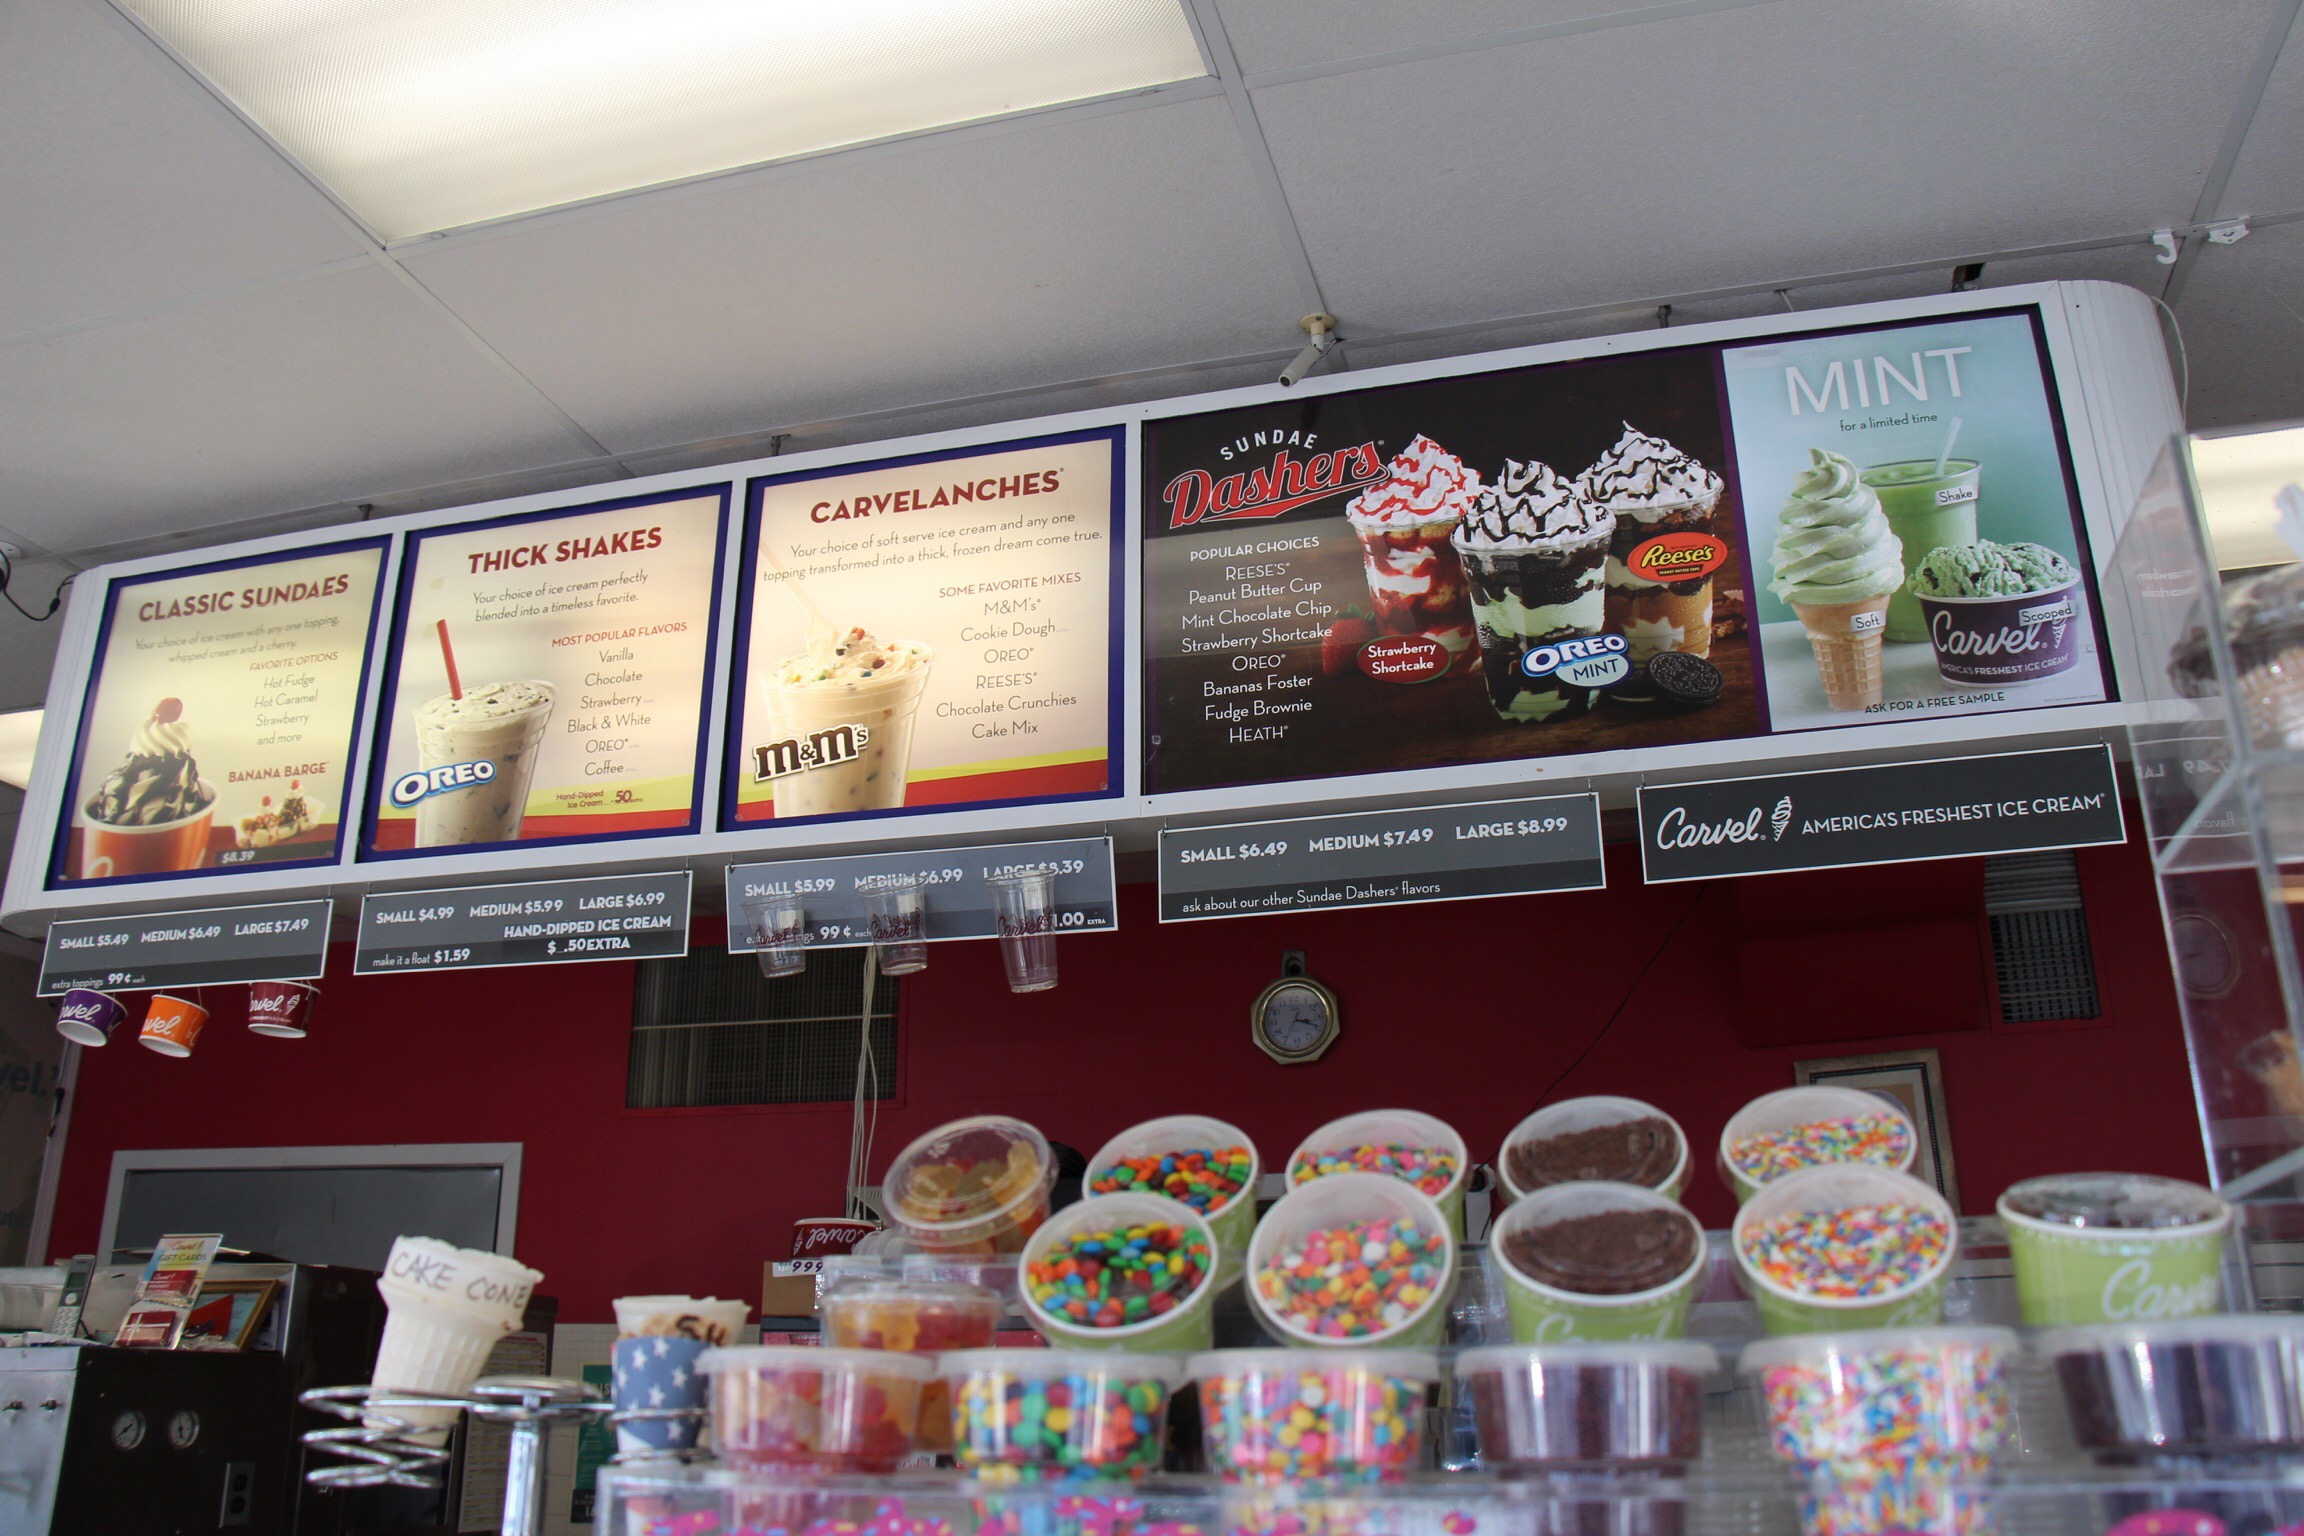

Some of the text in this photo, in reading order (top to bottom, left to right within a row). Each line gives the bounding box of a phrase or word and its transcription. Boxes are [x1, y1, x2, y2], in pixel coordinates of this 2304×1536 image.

[1785, 346, 1972, 416] MINT
[1840, 412, 1938, 432] for a limited time
[1220, 429, 1318, 461] SUNDAE
[811, 469, 1061, 524] CARVELANCHES
[1163, 440, 1390, 530] Dashers
[1939, 489, 1973, 504] Shake
[791, 514, 1075, 558] Your choice of soft serve ice cream and any one
[469, 527, 662, 574] THICK SHAKES
[1190, 537, 1319, 562] POPULAR CHOICES
[1641, 544, 1716, 568] Reese's
[473, 570, 648, 605] Your choice of ice cream perfectly
[939, 572, 1081, 598] SOME FAVORITE MIXES
[1190, 578, 1321, 604] Peanut Butter Cup
[139, 573, 349, 622] CLASSIC SUNDAES
[1182, 601, 1332, 629] Mint Chocolate Chip
[1856, 614, 1880, 629] Soft
[2021, 604, 2072, 624] Scooped
[552, 622, 687, 648] MOST POPULAR FLAVORS
[961, 619, 1056, 642] Cookie Dough
[1182, 623, 1332, 653] Strawberry Shortcake
[250, 652, 338, 671] FAVORITE OPTIONS
[599, 648, 633, 664] Vanilla
[1367, 642, 1436, 660] Strawberry
[1525, 635, 1627, 674] OREO
[1372, 657, 1434, 675] Shortcake
[1572, 657, 1618, 686] MINT
[264, 674, 315, 689] Hot Fudge
[585, 671, 642, 687] Chocolate
[1204, 675, 1313, 696] Bananas Foster
[255, 690, 318, 708] Hot Caramel
[580, 695, 642, 710] Strawberry
[937, 694, 1076, 718] Chocolate Crunchies
[1205, 699, 1312, 722] Fudge Brownie
[1865, 691, 2004, 714] ASK FOR A FREE SAMPLE
[256, 713, 309, 728] Strawberry
[567, 718, 597, 733] Black
[615, 714, 651, 728] White
[972, 721, 1038, 739] Cake Mix
[228, 762, 326, 783] BANANA BARGE
[585, 762, 623, 776] Coffee
[393, 761, 494, 803] OREO
[1802, 812, 1899, 835] AMERICA'S
[1903, 803, 1992, 826] FRESHEST
[1998, 801, 2029, 817] ICE
[2033, 796, 2101, 814] CREAM
[1180, 817, 1567, 863] SMALL $6.49 MEDIUM $7.49 LARGE $8.99
[745, 880, 791, 897] SMALL
[794, 878, 835, 894] $5.99
[854, 874, 915, 890] MEDIUM
[919, 868, 963, 885] $6.99
[377, 892, 665, 924] SMALL $4.99 MEDIUM $5.99 LARGE $6.99
[1182, 900, 1201, 913] ask
[1204, 896, 1236, 911] about
[1240, 897, 1259, 909] our
[1263, 892, 1293, 907] other
[1297, 886, 1342, 904] Sundae
[1402, 880, 1440, 896] flavors
[60, 918, 309, 949] SMALL $5.49 MEDIUM $6.49 LARGE $7.49
[504, 916, 671, 938] HAND-DIPPED ICE CREAM
[373, 955, 394, 966] make
[397, 955, 402, 965] it
[412, 952, 430, 965] float
[434, 948, 470, 964] $1.59
[52, 980, 70, 989] extra
[108, 974, 122, 984] 99
[392, 1252, 528, 1309] CAKE CONE
